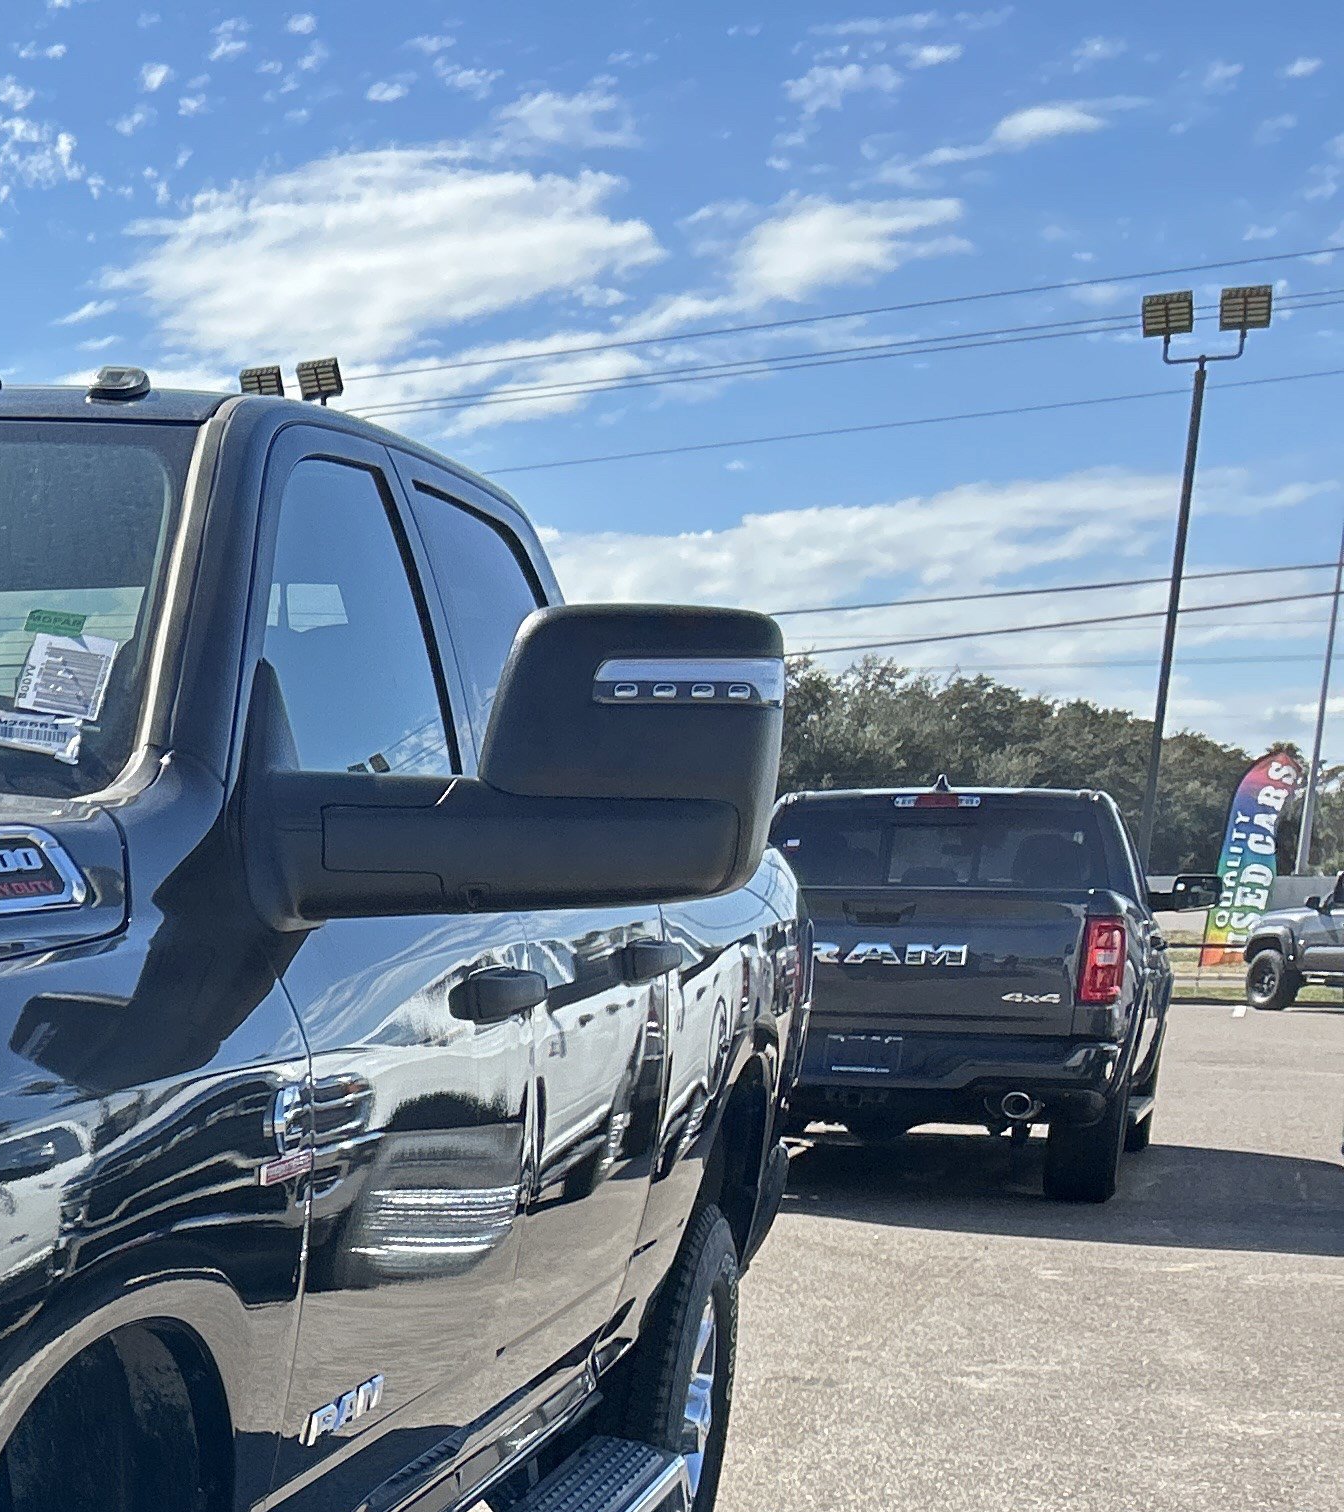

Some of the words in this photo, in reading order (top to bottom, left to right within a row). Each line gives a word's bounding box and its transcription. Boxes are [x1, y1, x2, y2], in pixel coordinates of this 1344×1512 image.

[1246, 760, 1298, 856] CARS
[13, 879, 56, 896] DUTY
[1215, 810, 1251, 928] QUALITY
[1224, 863, 1274, 954] USED
[812, 941, 969, 967] RAM
[1001, 991, 1061, 1004] 4x4
[299, 1373, 386, 1448] RAM
